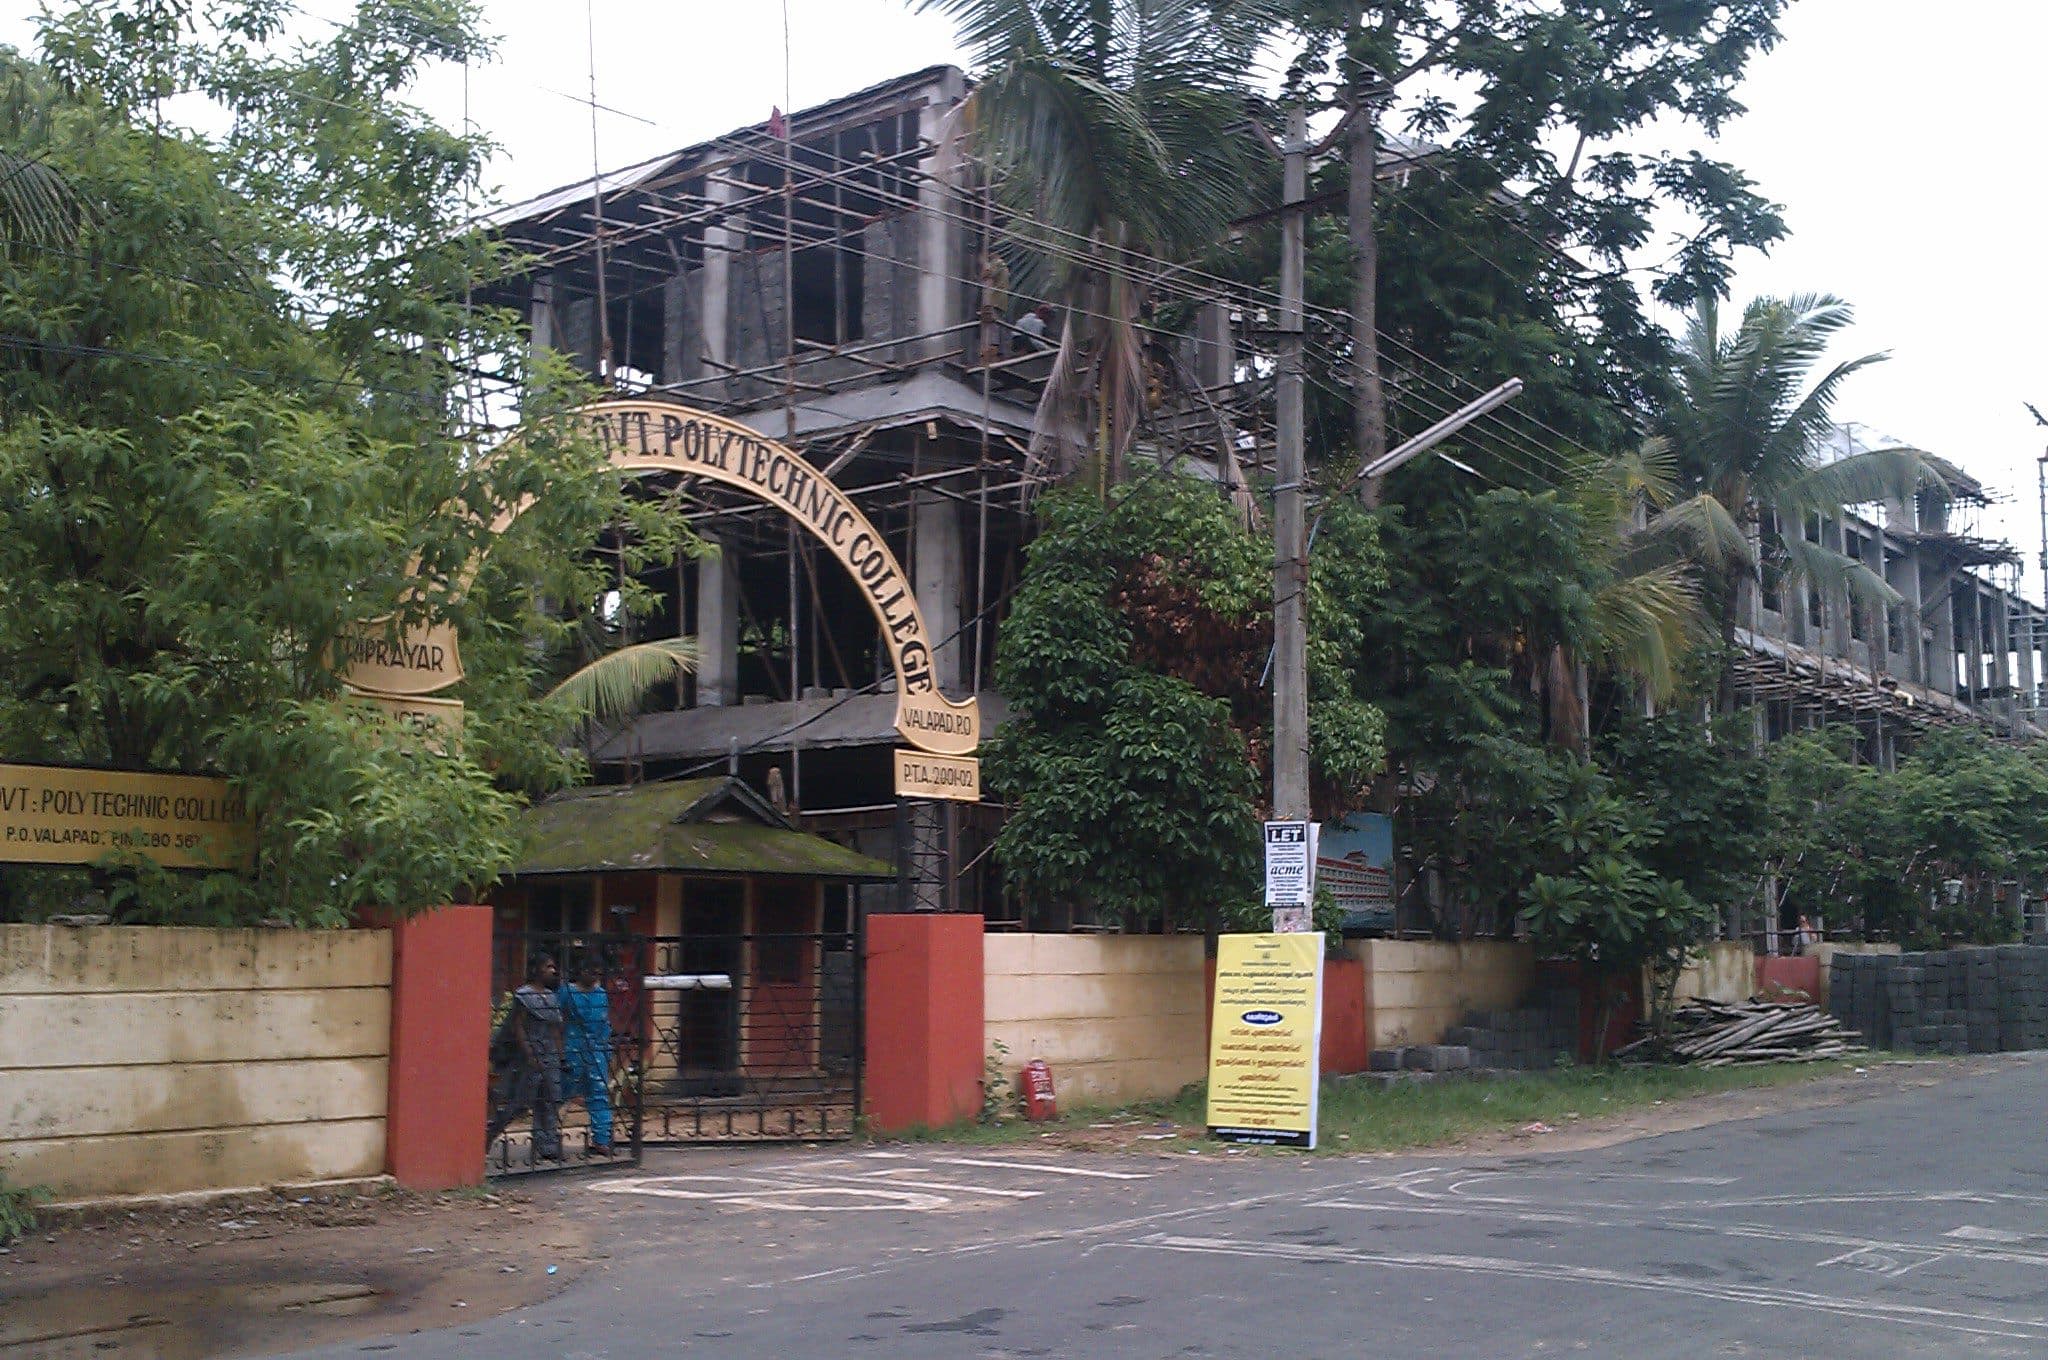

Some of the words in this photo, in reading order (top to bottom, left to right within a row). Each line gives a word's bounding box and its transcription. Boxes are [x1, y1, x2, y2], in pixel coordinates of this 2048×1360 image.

[661, 414, 855, 547] POLYTECHNIC
[849, 532, 933, 696] COLLEGE
[0, 787, 38, 813] VT:
[42, 788, 169, 820] POLYTECHNIC
[1271, 829, 1301, 842] LET
[1270, 865, 1304, 875] acme
